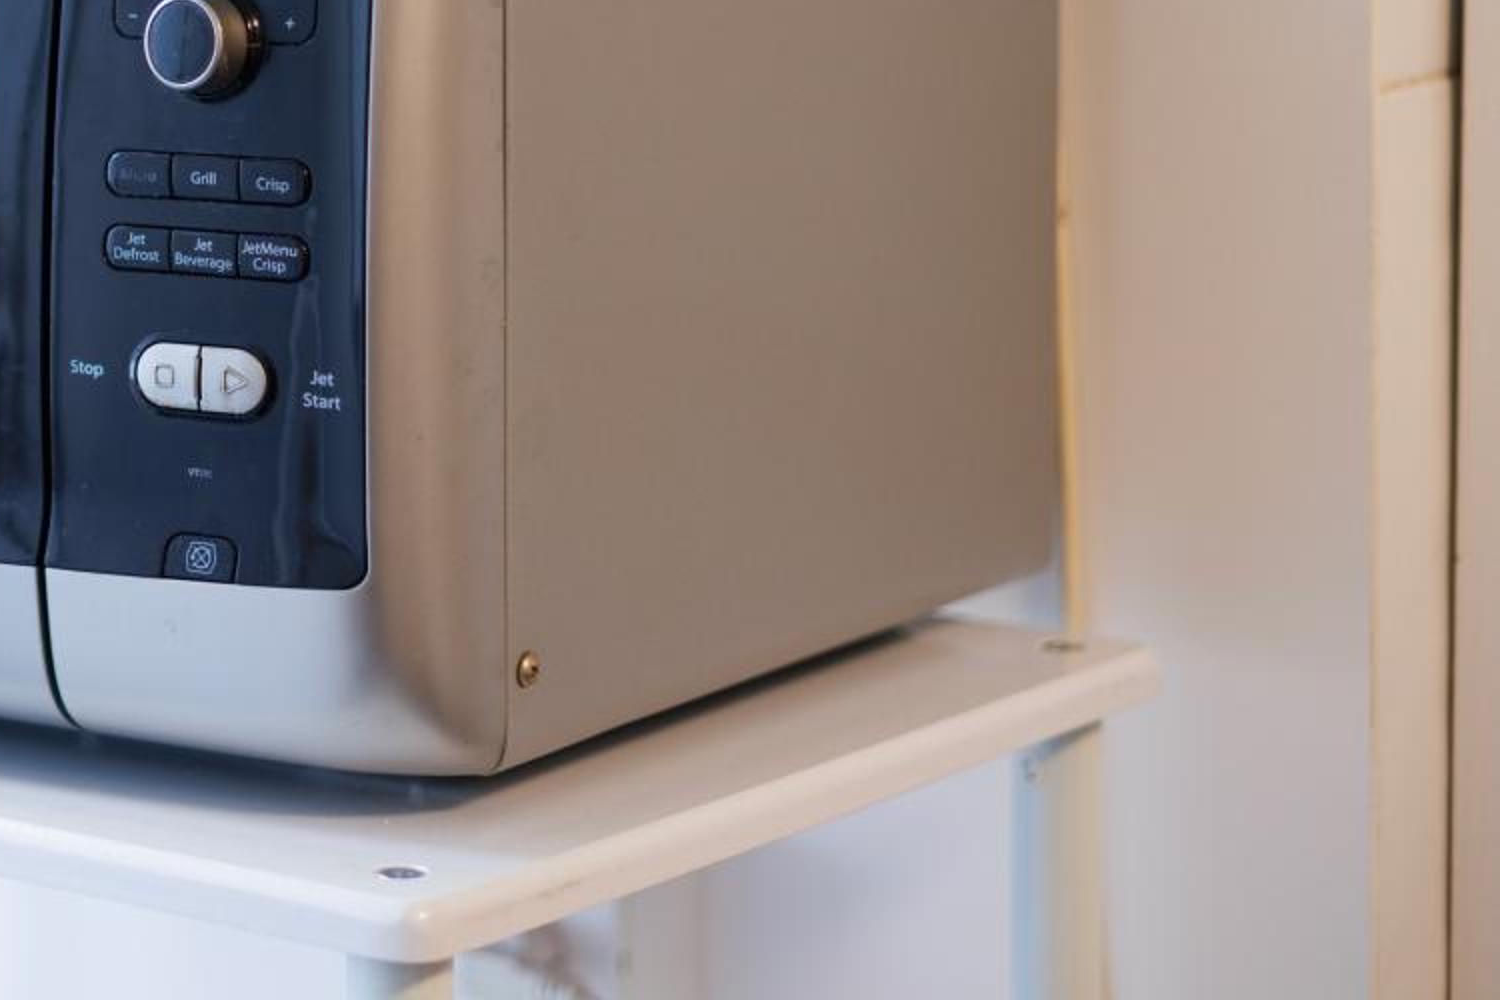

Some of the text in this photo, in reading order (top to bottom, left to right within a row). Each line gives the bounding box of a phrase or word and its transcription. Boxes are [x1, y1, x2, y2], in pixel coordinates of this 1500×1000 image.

[190, 172, 217, 186] Grill
[255, 177, 290, 194] Crisp
[127, 232, 146, 246] Jet
[194, 238, 213, 251] Jet
[113, 246, 160, 263] Defrost
[242, 240, 298, 257] JetMenu
[174, 252, 233, 273] Beverage
[252, 257, 287, 275] Crisp
[70, 359, 104, 377] Stop
[309, 370, 334, 387] Jet
[303, 392, 341, 411] Start
